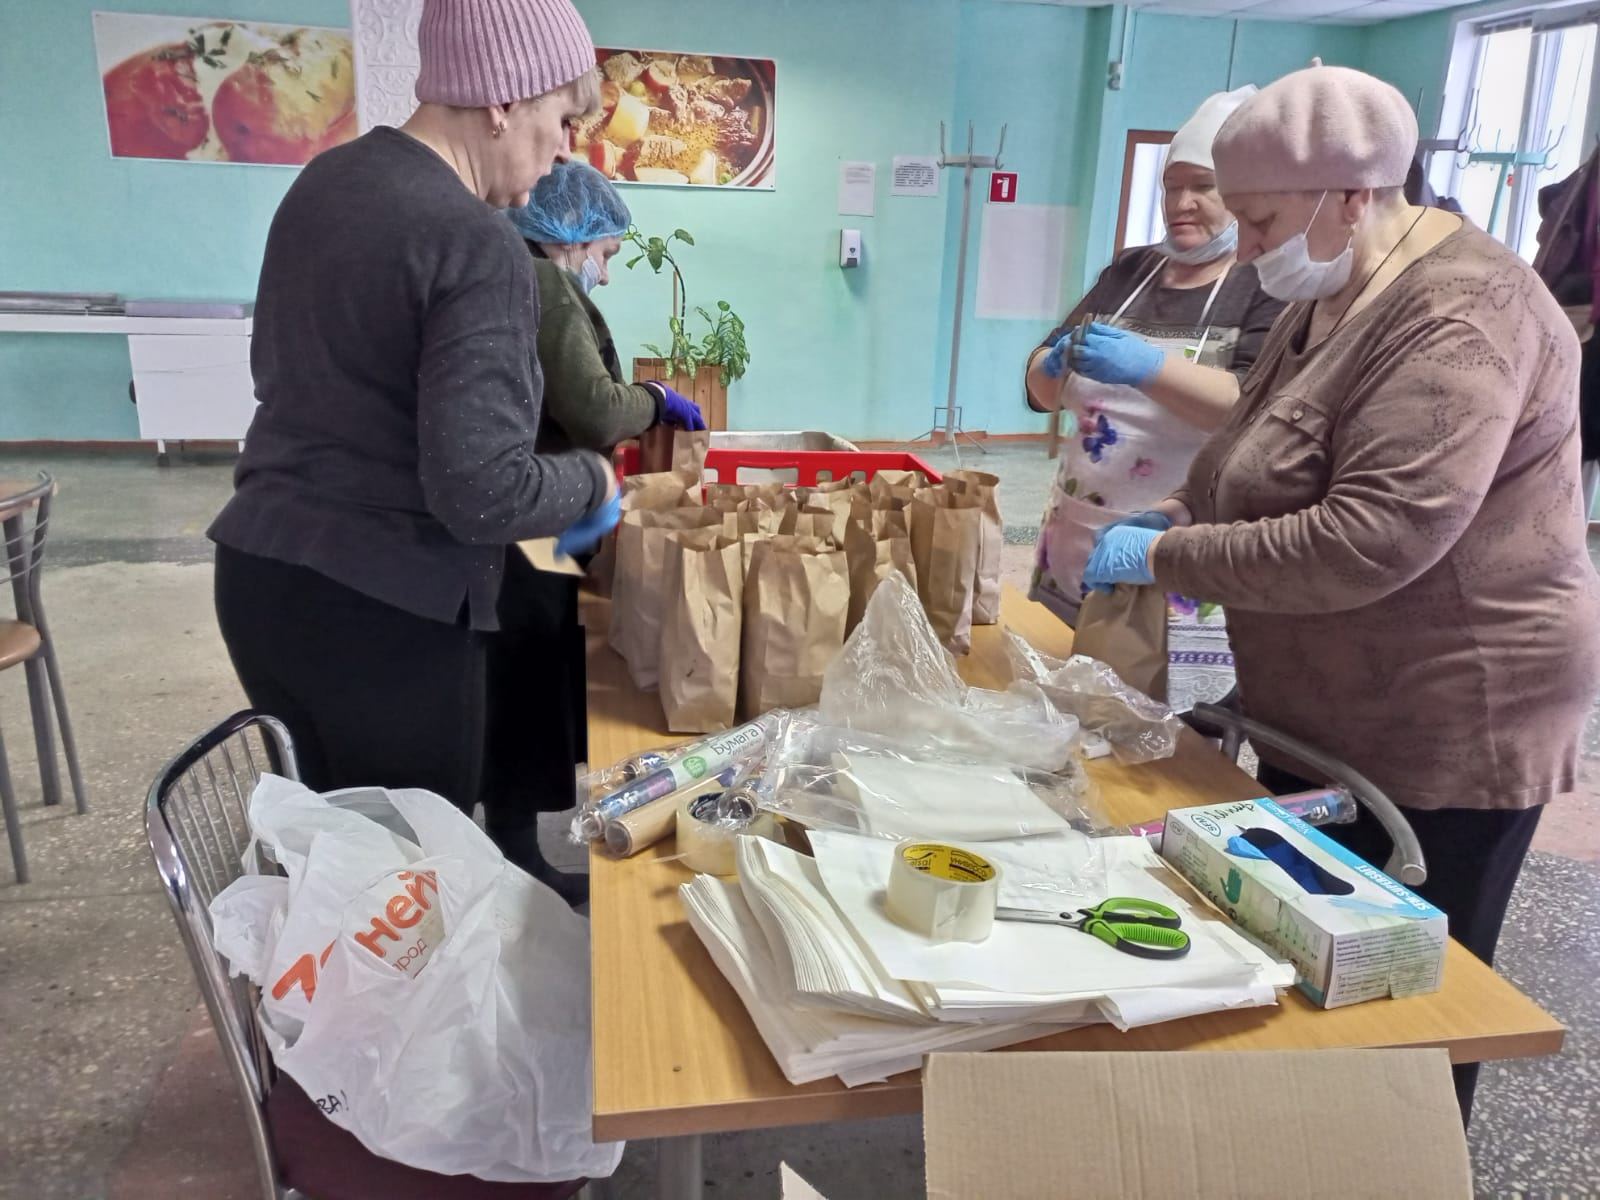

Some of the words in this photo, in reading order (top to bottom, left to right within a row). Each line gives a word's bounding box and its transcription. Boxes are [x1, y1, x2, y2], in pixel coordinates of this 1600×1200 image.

[710, 728, 759, 755] Бумага
[1195, 816, 1218, 832] SFM
[322, 869, 438, 968] ней
